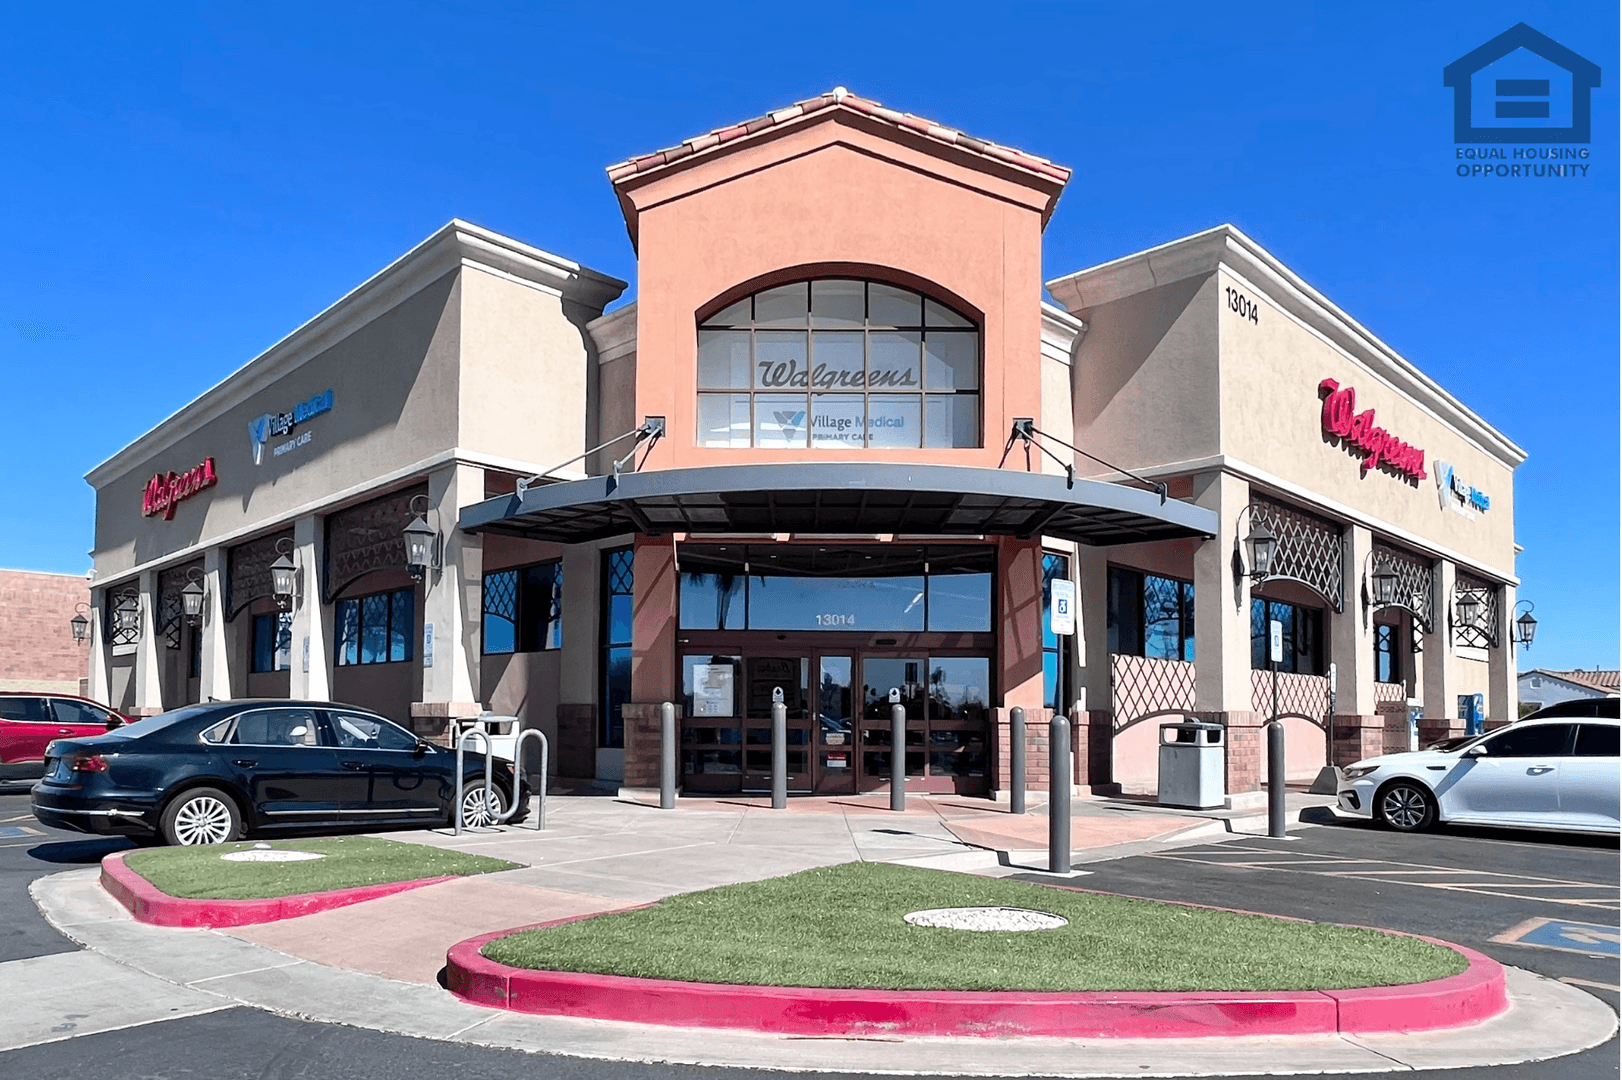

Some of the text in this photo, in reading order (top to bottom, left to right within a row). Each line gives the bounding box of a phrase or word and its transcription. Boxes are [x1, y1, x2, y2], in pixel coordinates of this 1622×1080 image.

[1225, 286, 1259, 326] 13014
[758, 358, 918, 396] Walgreens
[810, 415, 905, 431] Village Medical
[1318, 377, 1427, 480] Walgreens
[812, 433, 874, 441] PRIMARY CAE
[815, 613, 856, 626] 13014
